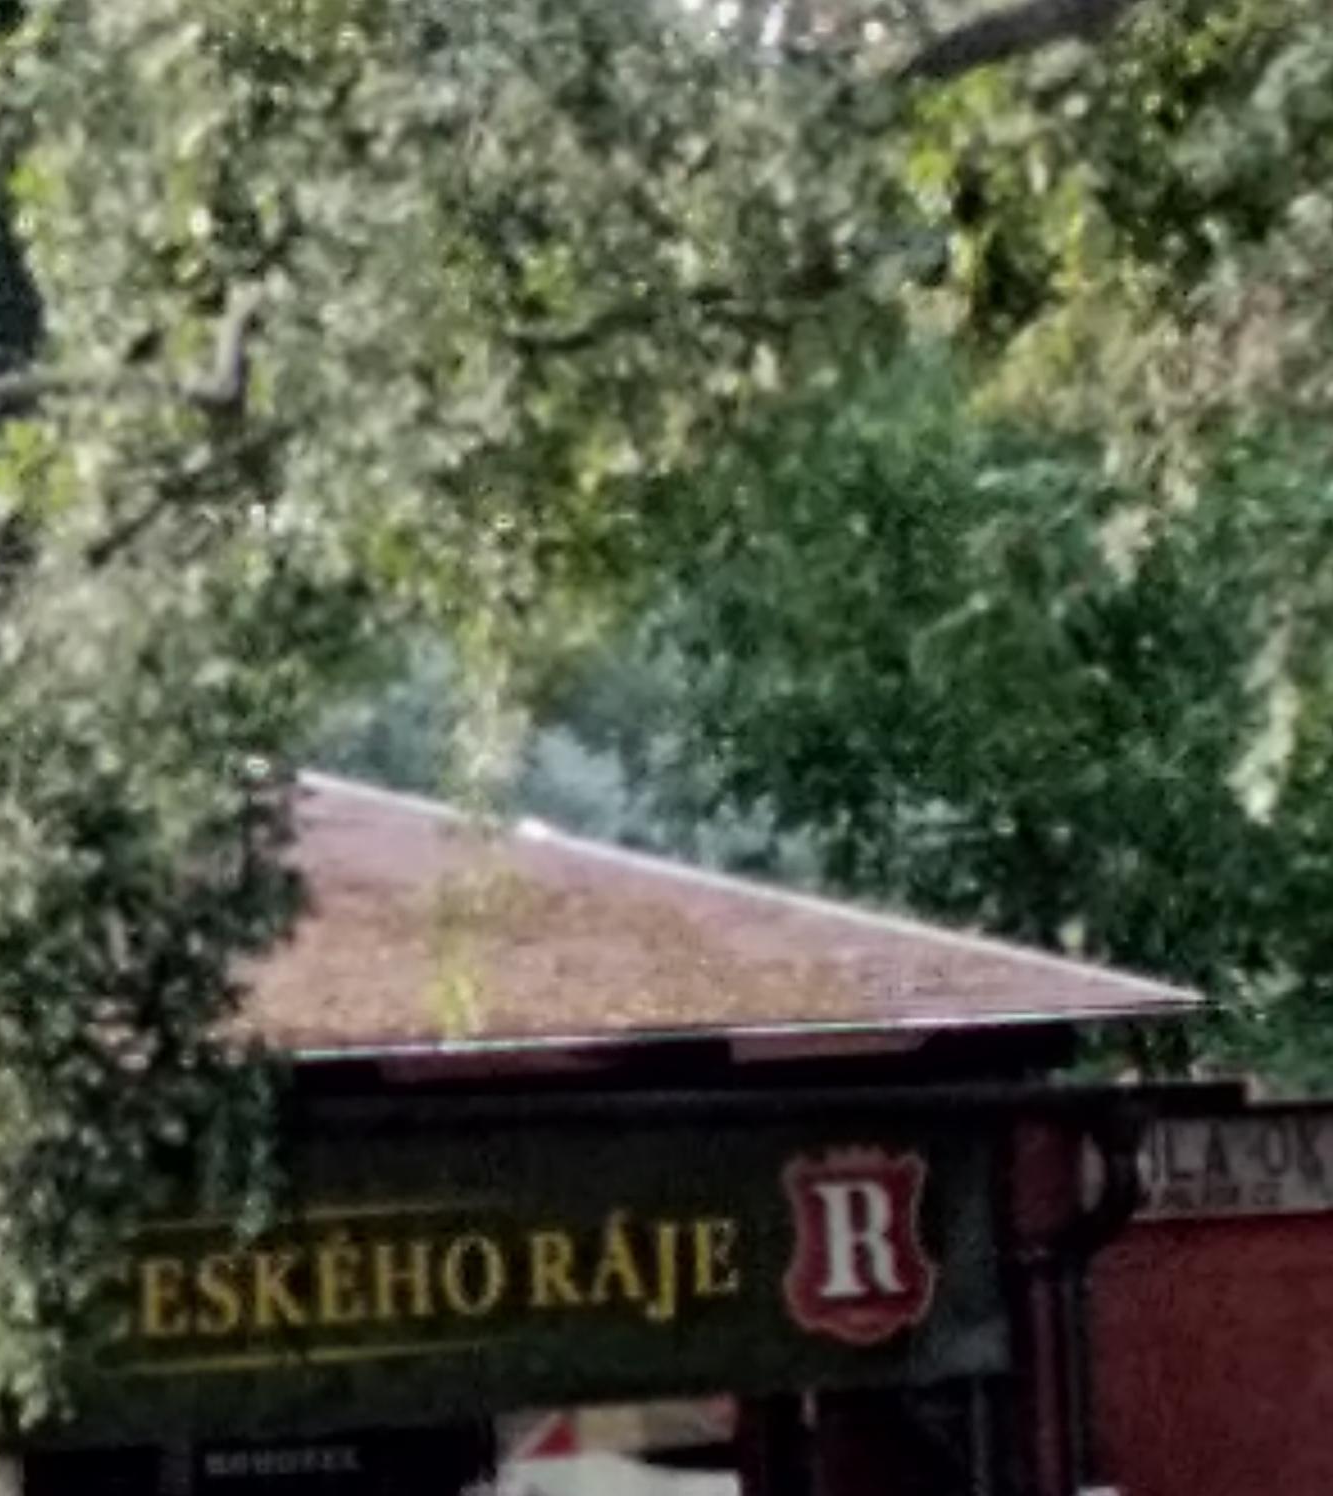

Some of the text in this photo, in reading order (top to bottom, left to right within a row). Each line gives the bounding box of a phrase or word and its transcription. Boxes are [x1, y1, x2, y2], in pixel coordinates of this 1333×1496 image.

[128, 1230, 507, 1340] ESKÉHO
[532, 1208, 740, 1324] RÁJE
[815, 1182, 906, 1299] R
